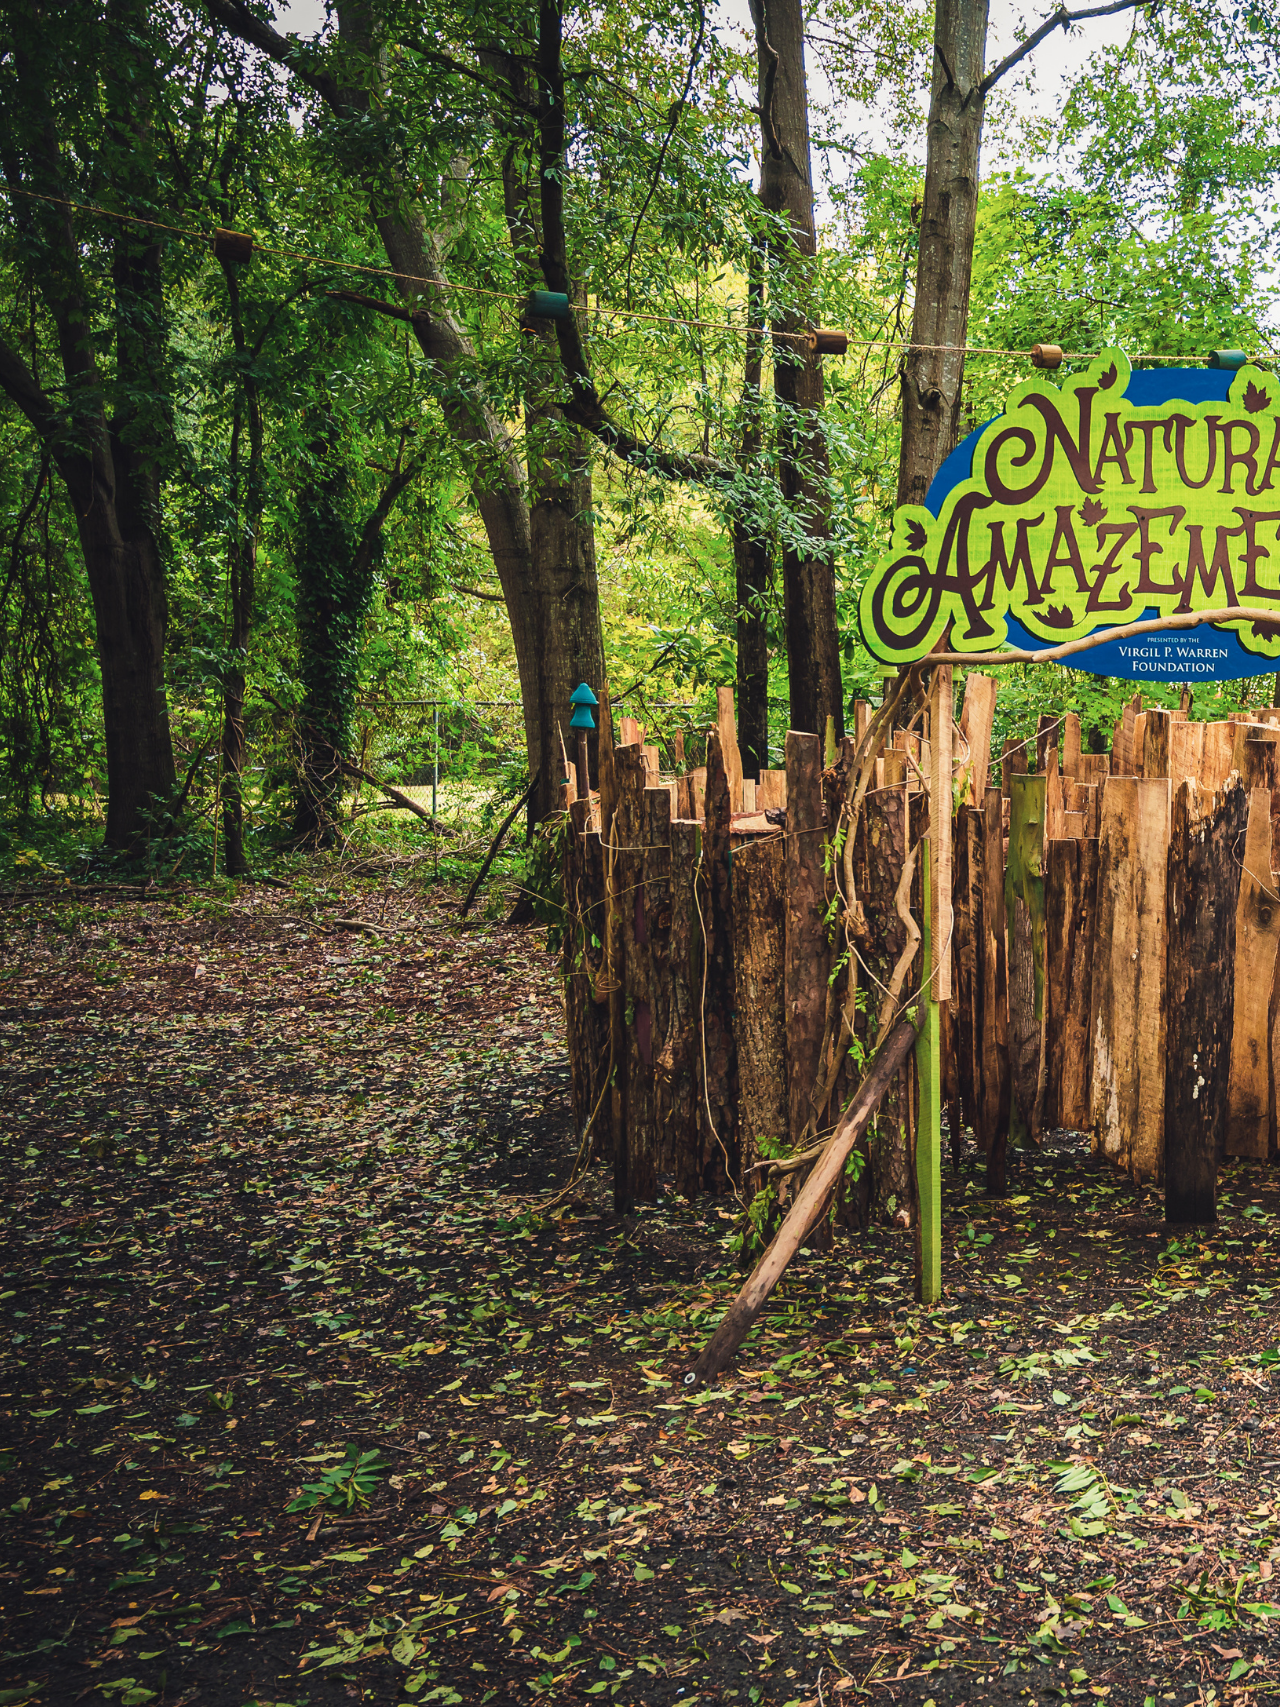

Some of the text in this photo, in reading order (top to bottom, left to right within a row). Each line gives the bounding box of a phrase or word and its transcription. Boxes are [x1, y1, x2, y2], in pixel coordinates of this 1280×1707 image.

[1119, 646, 1228, 658] VIRGIL P. WARREN
[1132, 660, 1215, 672] FOUNDATION
